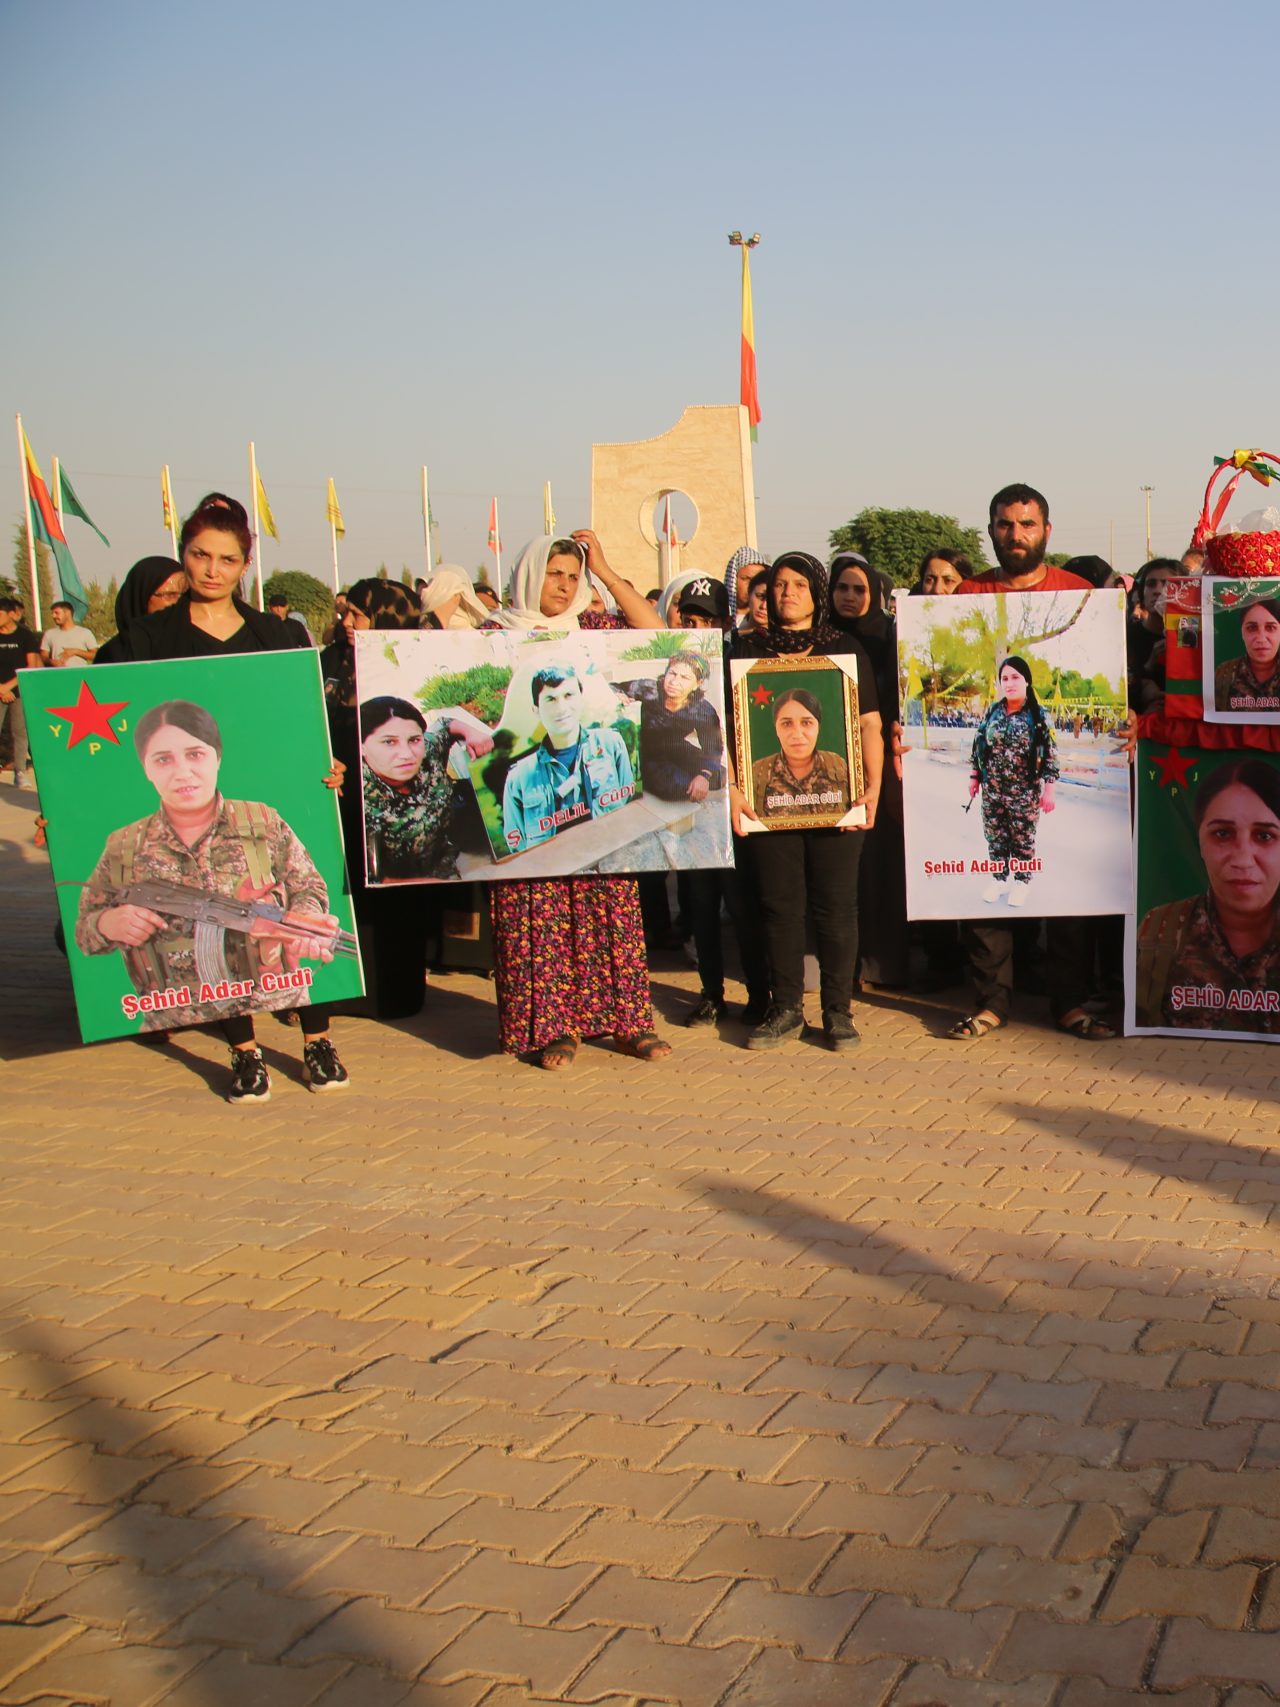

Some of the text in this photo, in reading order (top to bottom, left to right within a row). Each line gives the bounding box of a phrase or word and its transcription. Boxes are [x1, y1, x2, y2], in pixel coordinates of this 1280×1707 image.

[690, 579, 711, 596] NY
[1256, 696, 1279, 707] ADAR
[539, 802, 591, 832] DELÎL
[599, 782, 637, 807] CÛDÎ
[795, 793, 820, 806] ADAR
[970, 859, 1005, 874] Adar
[122, 967, 313, 1019] Şehîd Adar Cudî
[1172, 983, 1225, 1011] ŞEHÎD
[1227, 989, 1280, 1012] ADAR
